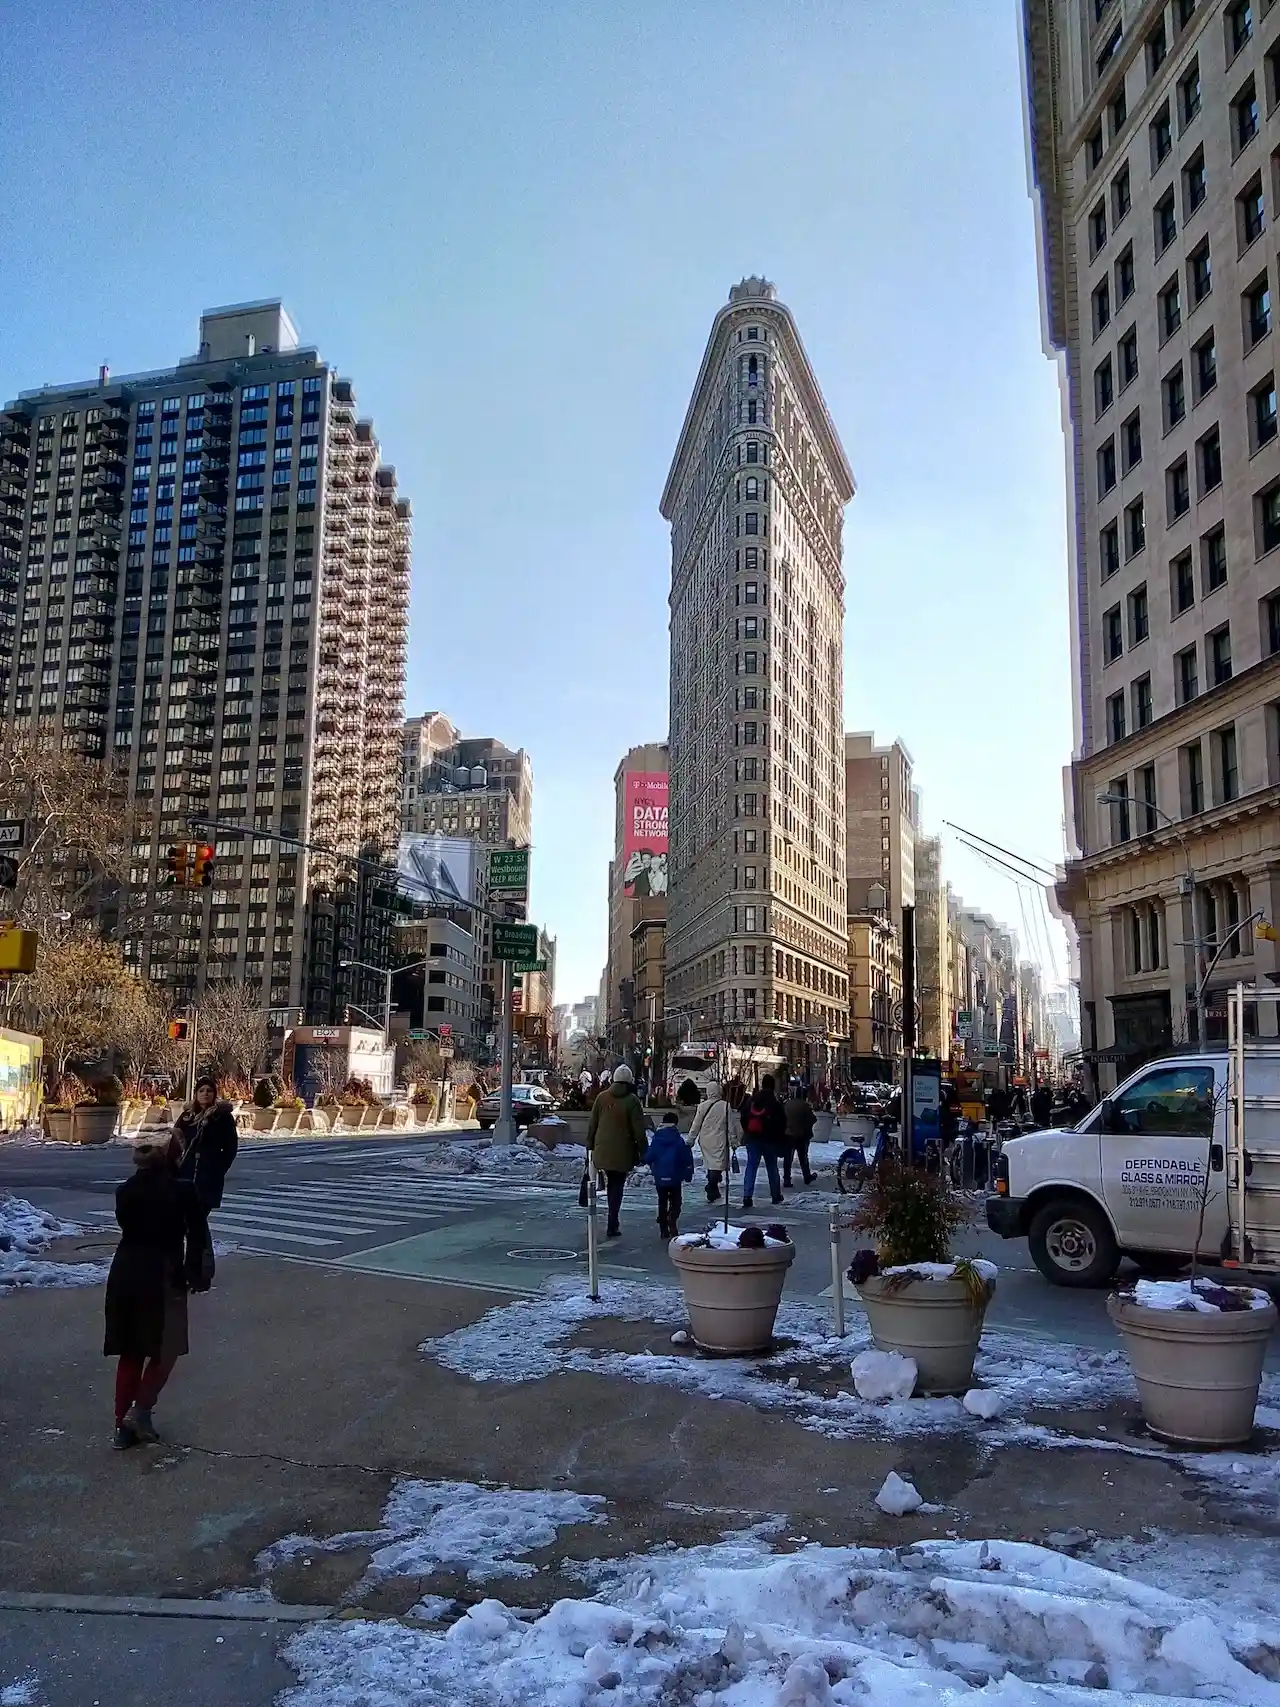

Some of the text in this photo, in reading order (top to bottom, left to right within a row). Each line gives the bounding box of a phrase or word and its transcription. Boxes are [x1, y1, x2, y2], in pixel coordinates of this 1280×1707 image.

[633, 806, 669, 821] DATA
[0, 828, 15, 840] AY
[493, 854, 525, 864] W 23 St
[491, 864, 527, 874] Westbound
[490, 874, 526, 884] KEEP RIGHT
[504, 930, 535, 942] Broadway
[516, 962, 544, 972] Broadway
[1125, 1159, 1201, 1172] DEPENDABLE
[1121, 1172, 1205, 1186] GLASS & MIRROR
